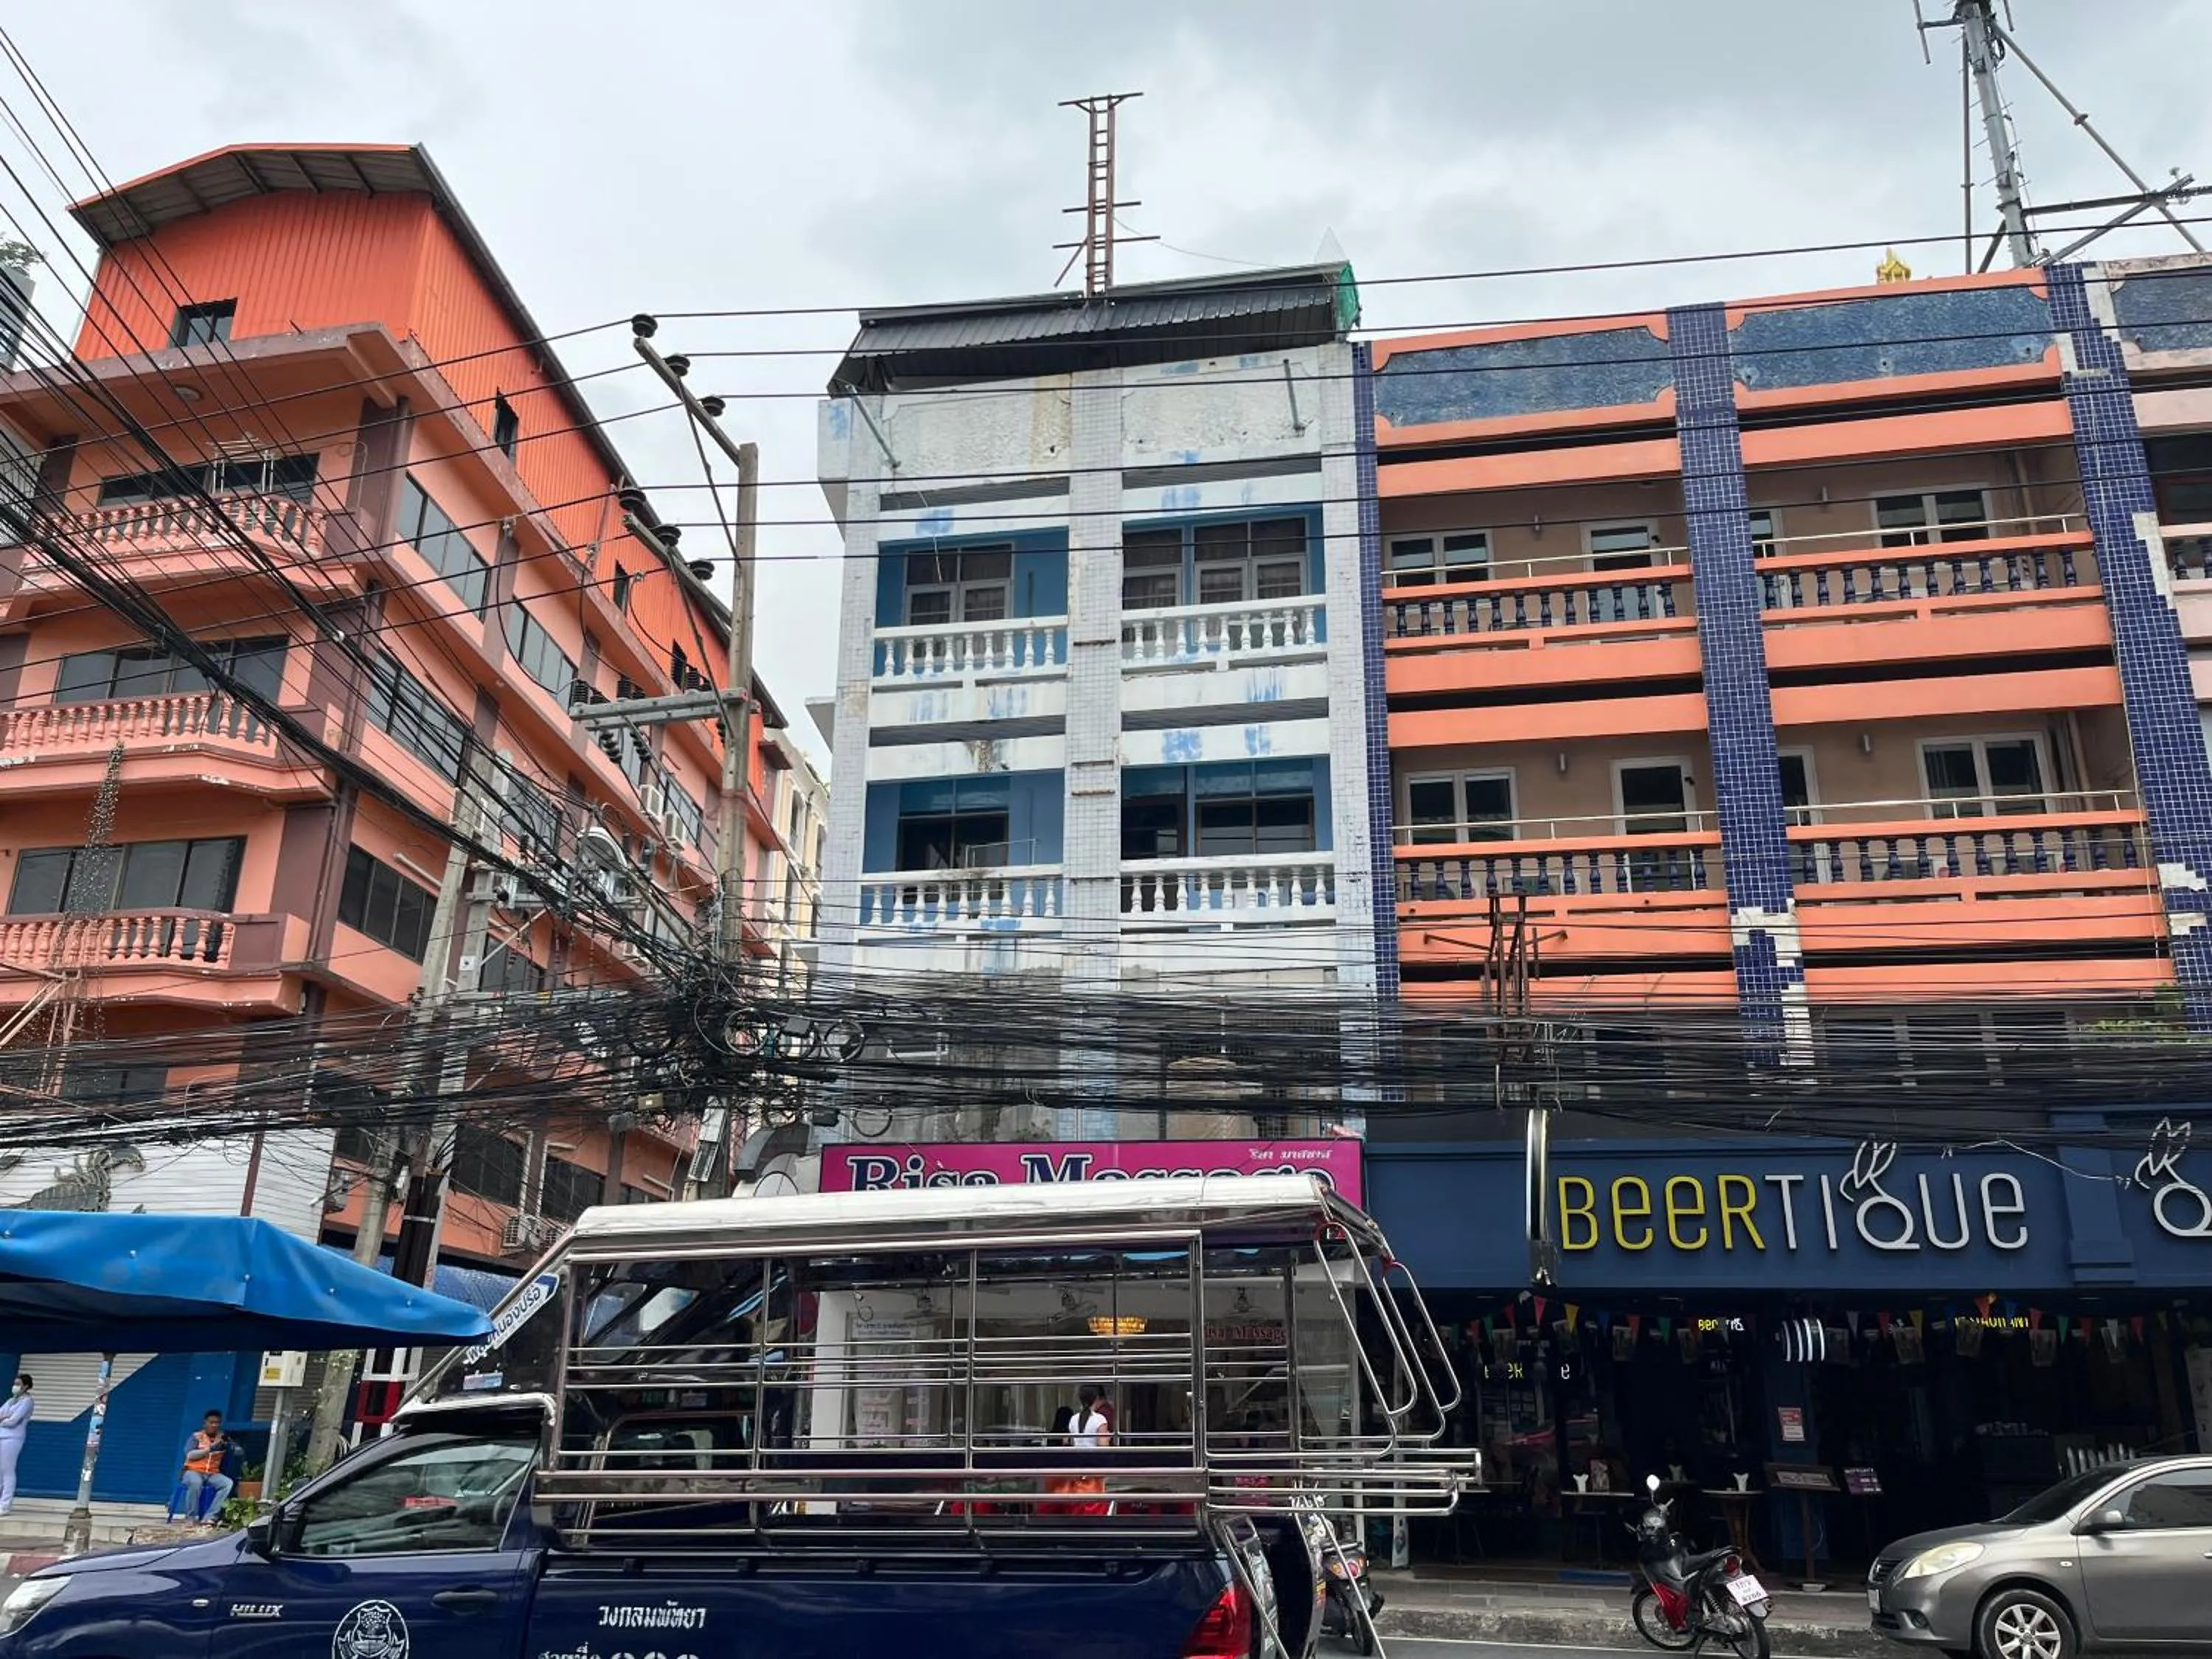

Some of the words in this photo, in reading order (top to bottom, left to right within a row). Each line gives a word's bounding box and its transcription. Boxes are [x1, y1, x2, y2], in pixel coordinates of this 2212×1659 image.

[230, 1604, 283, 1617] HILUX
[598, 1600, 706, 1629] วงกลมพัทยา
